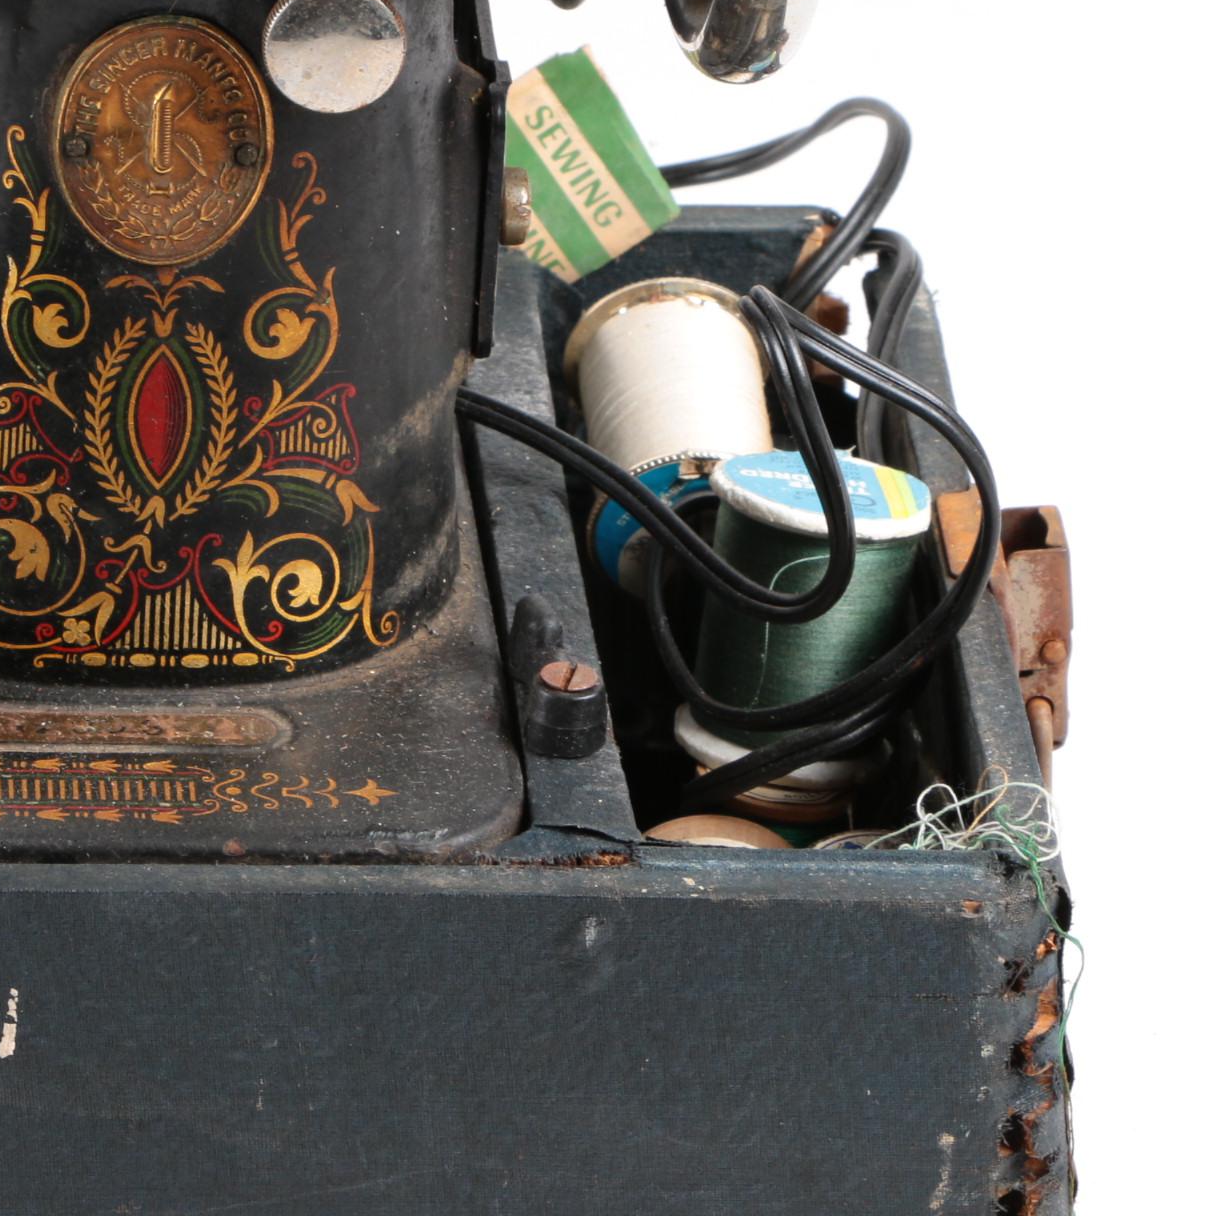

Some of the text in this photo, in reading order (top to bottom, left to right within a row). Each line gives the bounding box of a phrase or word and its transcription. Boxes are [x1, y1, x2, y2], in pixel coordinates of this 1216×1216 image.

[75, 95, 101, 136] THE
[88, 35, 169, 95] SINGER
[118, 185, 202, 217] TRADE MARK
[525, 105, 622, 228] SEWING
